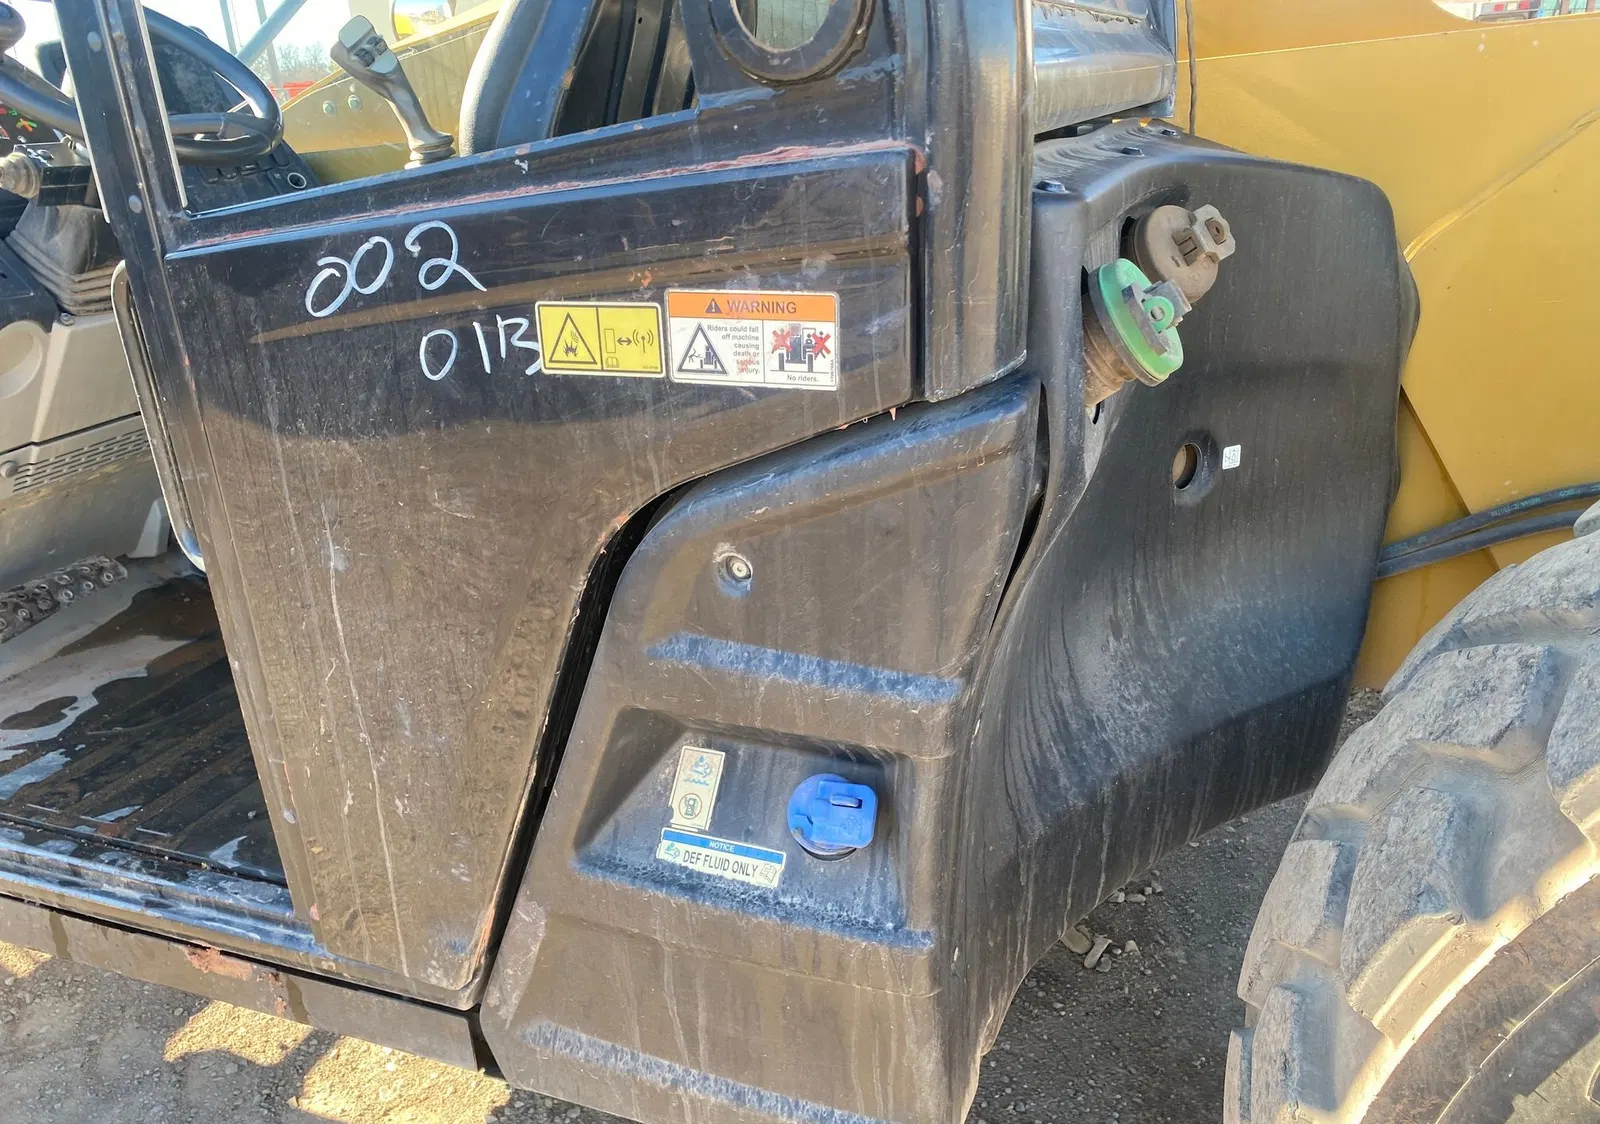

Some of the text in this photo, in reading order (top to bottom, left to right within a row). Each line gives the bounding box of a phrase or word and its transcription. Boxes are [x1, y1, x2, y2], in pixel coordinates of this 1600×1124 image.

[726, 299, 797, 314] WARNING
[707, 324, 728, 332] Riders
[733, 342, 760, 350] causing
[797, 374, 820, 382] riders.
[708, 841, 735, 853] NOTICE
[683, 850, 758, 878] DEF FLUID ONLY
